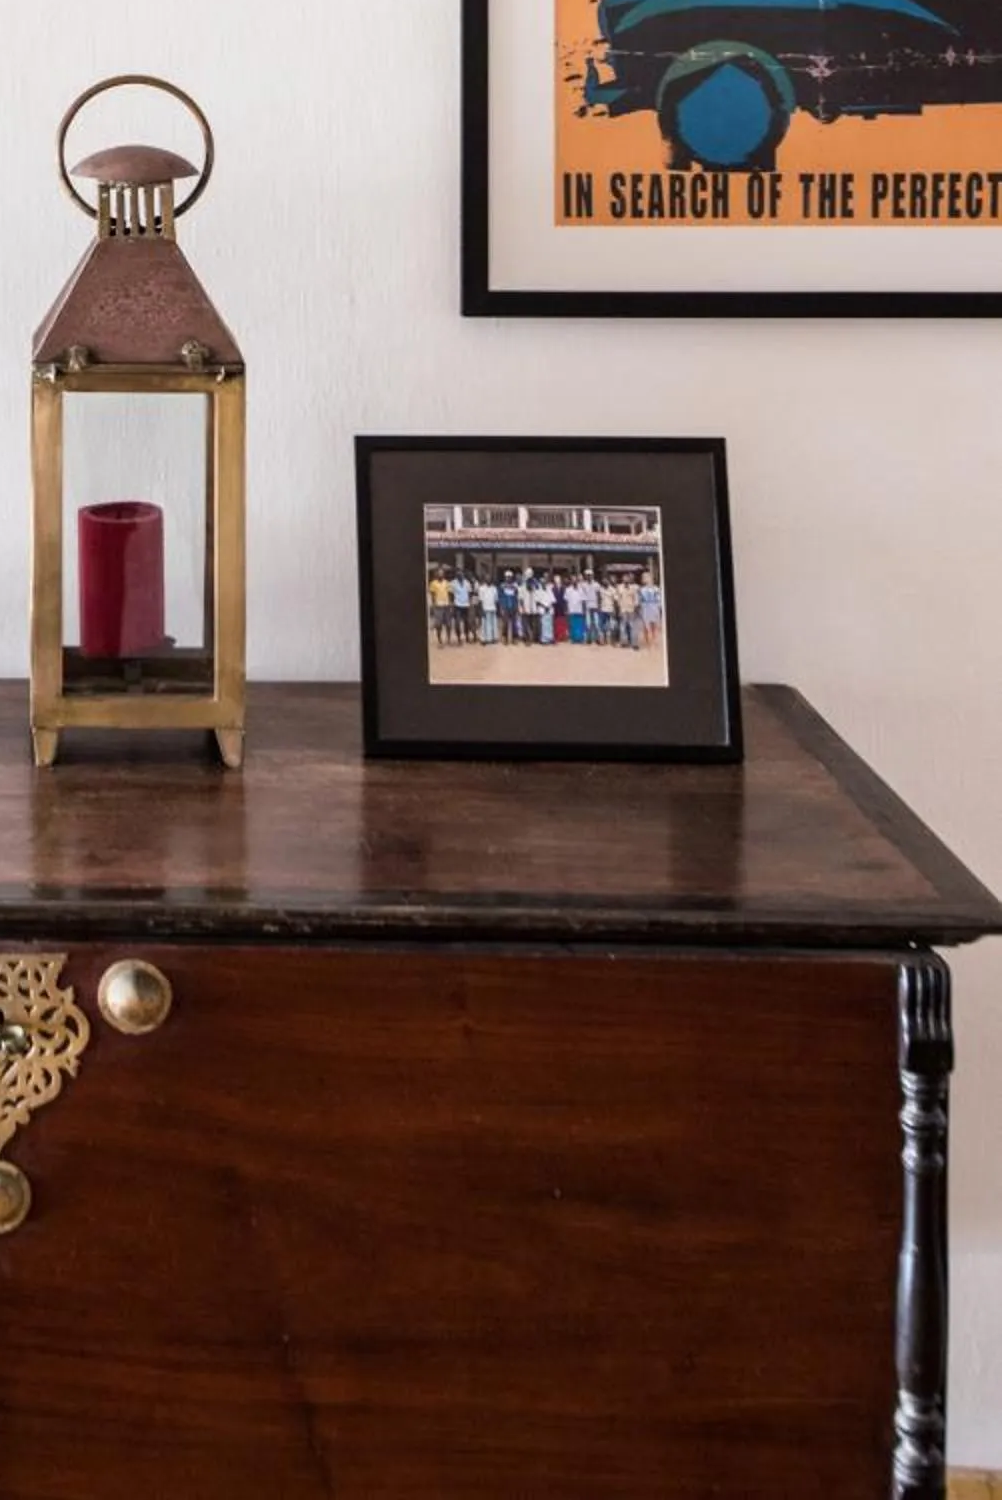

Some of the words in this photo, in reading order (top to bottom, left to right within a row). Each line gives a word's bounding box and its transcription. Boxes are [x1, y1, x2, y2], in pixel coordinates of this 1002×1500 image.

[563, 172, 594, 218] IN
[610, 172, 729, 218] SEARCH
[748, 172, 783, 218] OF
[799, 172, 855, 218] THE
[871, 172, 1002, 218] PERFECT
